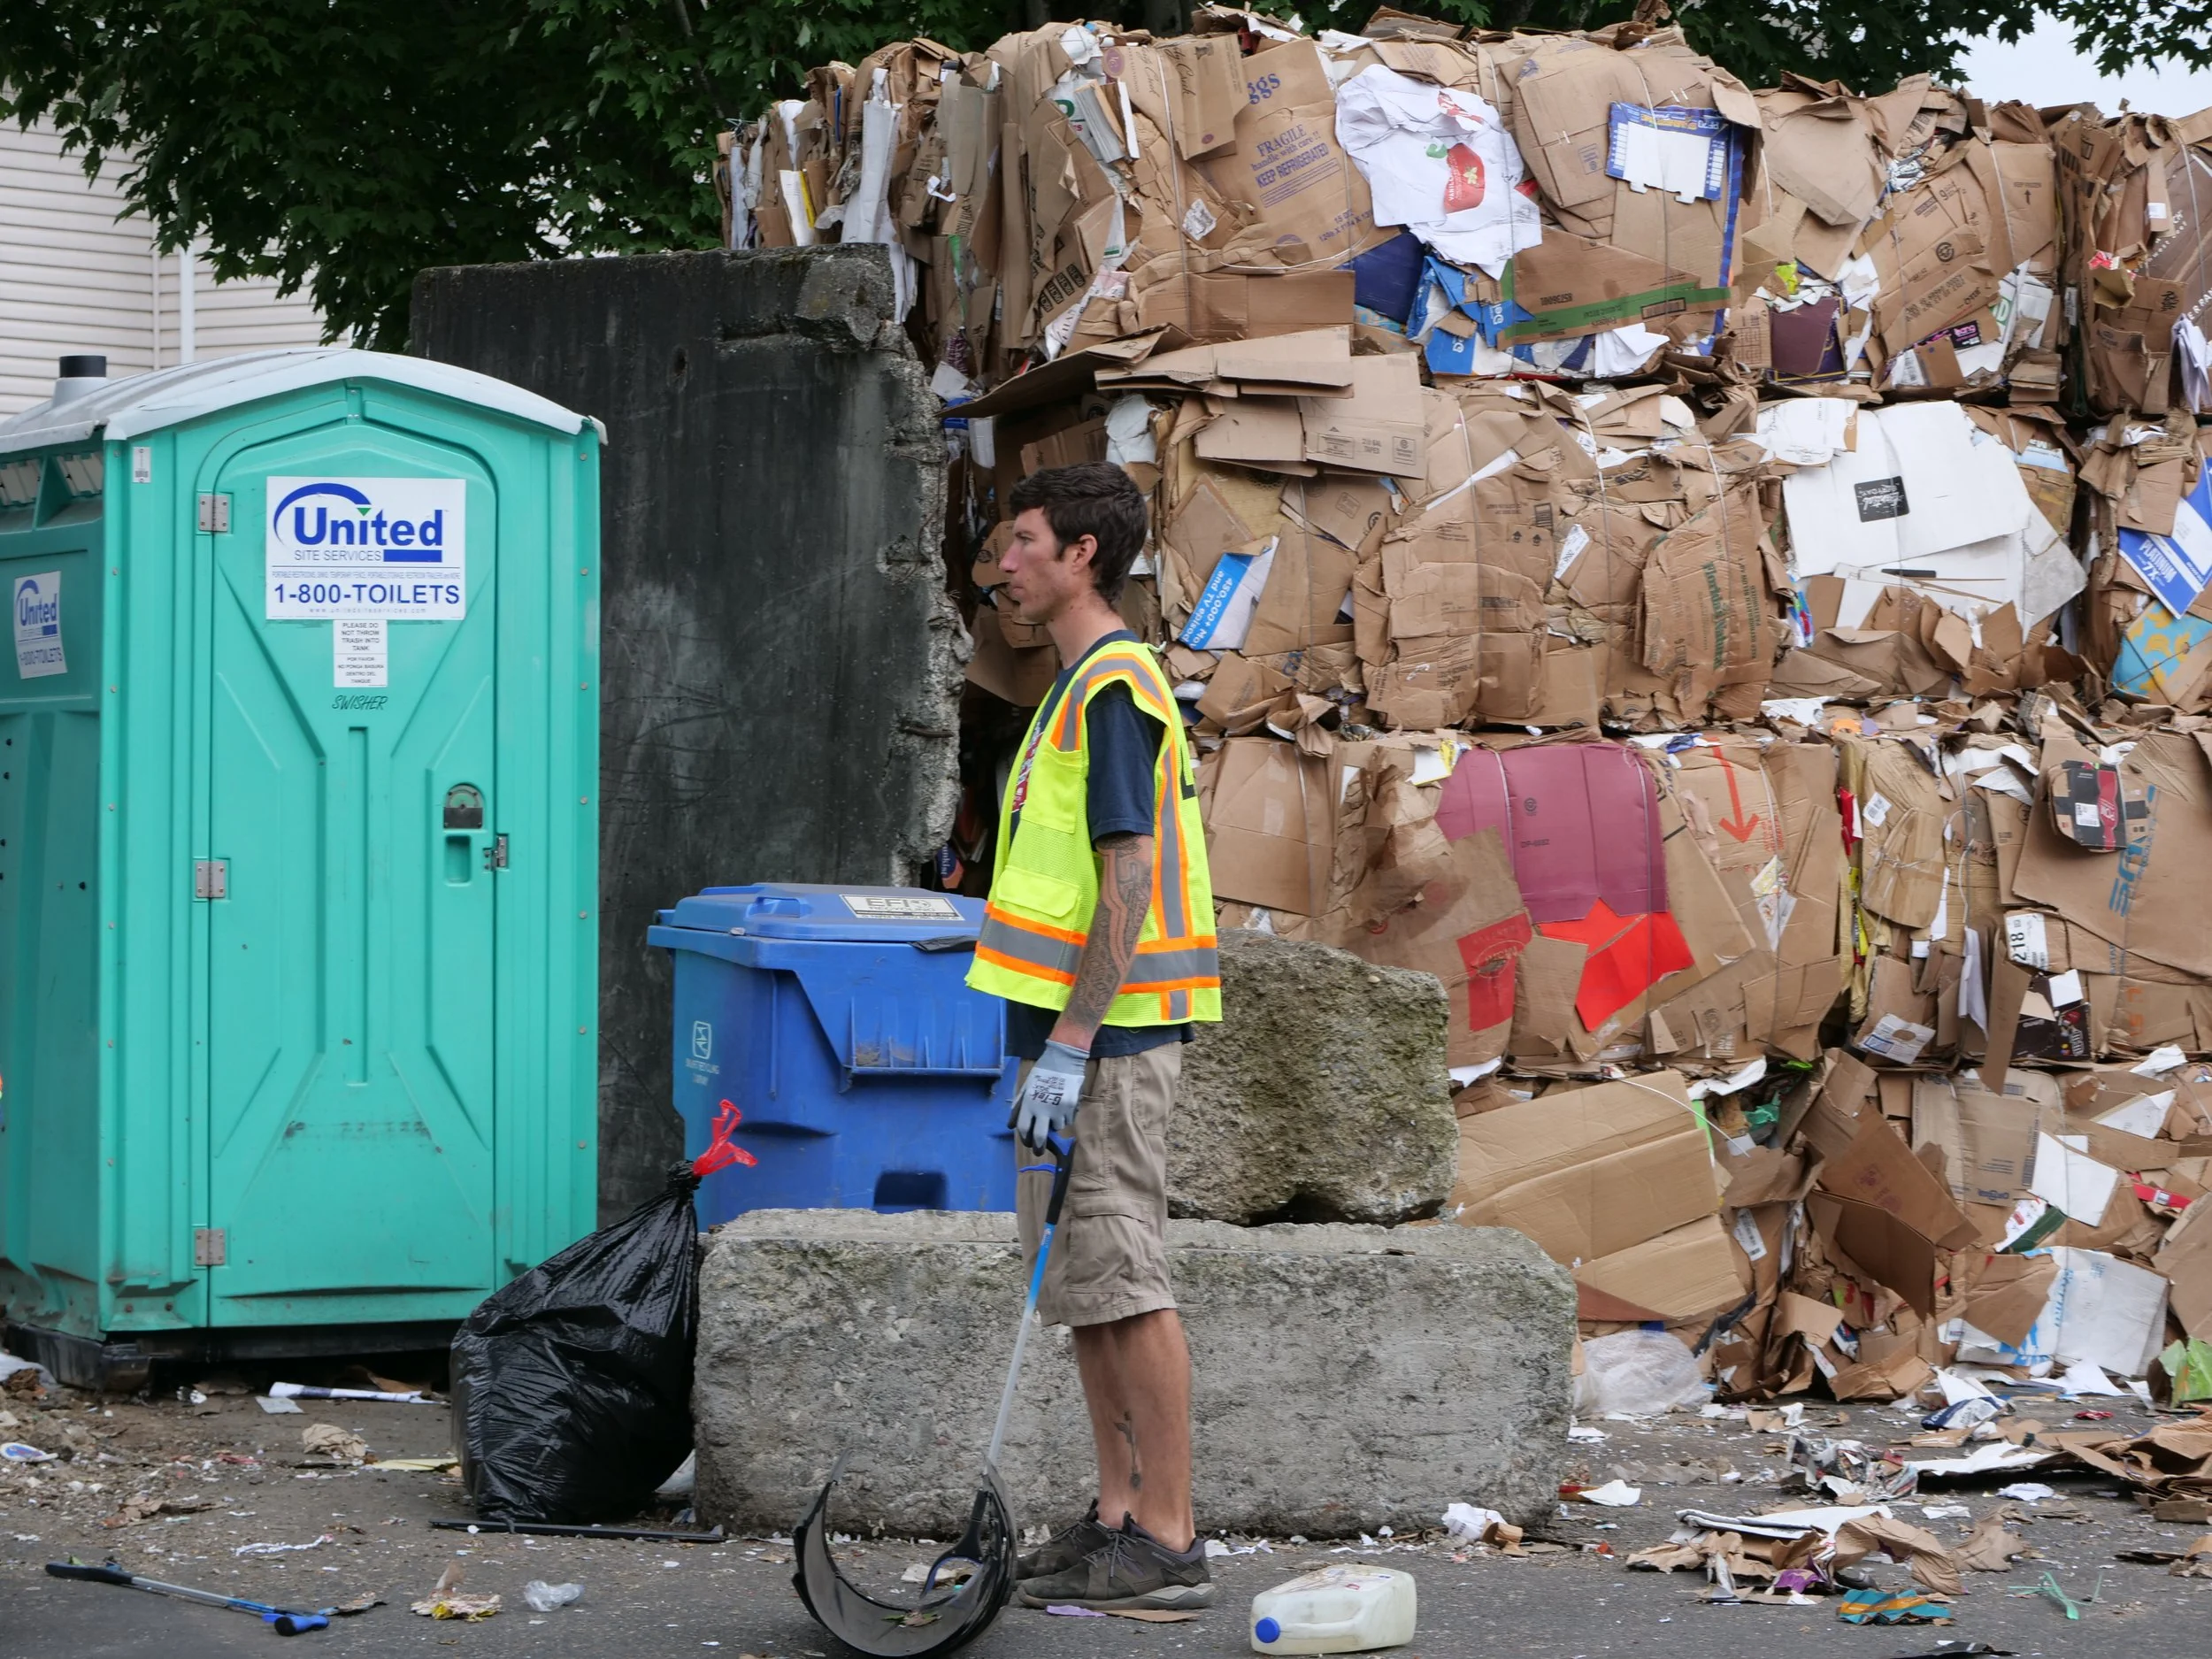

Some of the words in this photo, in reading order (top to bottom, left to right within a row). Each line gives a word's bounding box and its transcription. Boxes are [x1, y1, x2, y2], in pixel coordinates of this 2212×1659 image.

[1247, 73, 1281, 104] ggs
[1250, 154, 1280, 172] handle
[1280, 144, 1299, 158] with
[1298, 135, 1314, 150] care
[1256, 124, 1308, 157] FRAGILE
[1255, 169, 1277, 188] KEEP
[1276, 142, 1331, 178] REFRIGERATED
[294, 506, 442, 546] United
[294, 549, 320, 561] SITE
[324, 549, 382, 562] SERVICES
[2139, 538, 2178, 584] PLATINUM
[274, 583, 460, 604] 1-800-TOILETS
[1210, 570, 1225, 591] and
[19, 592, 58, 626] United
[1202, 592, 1216, 608] TV
[1204, 577, 1233, 628] 450,000+
[332, 695, 388, 710] SWISHER
[1030, 1088, 1062, 1106] G-Tek
